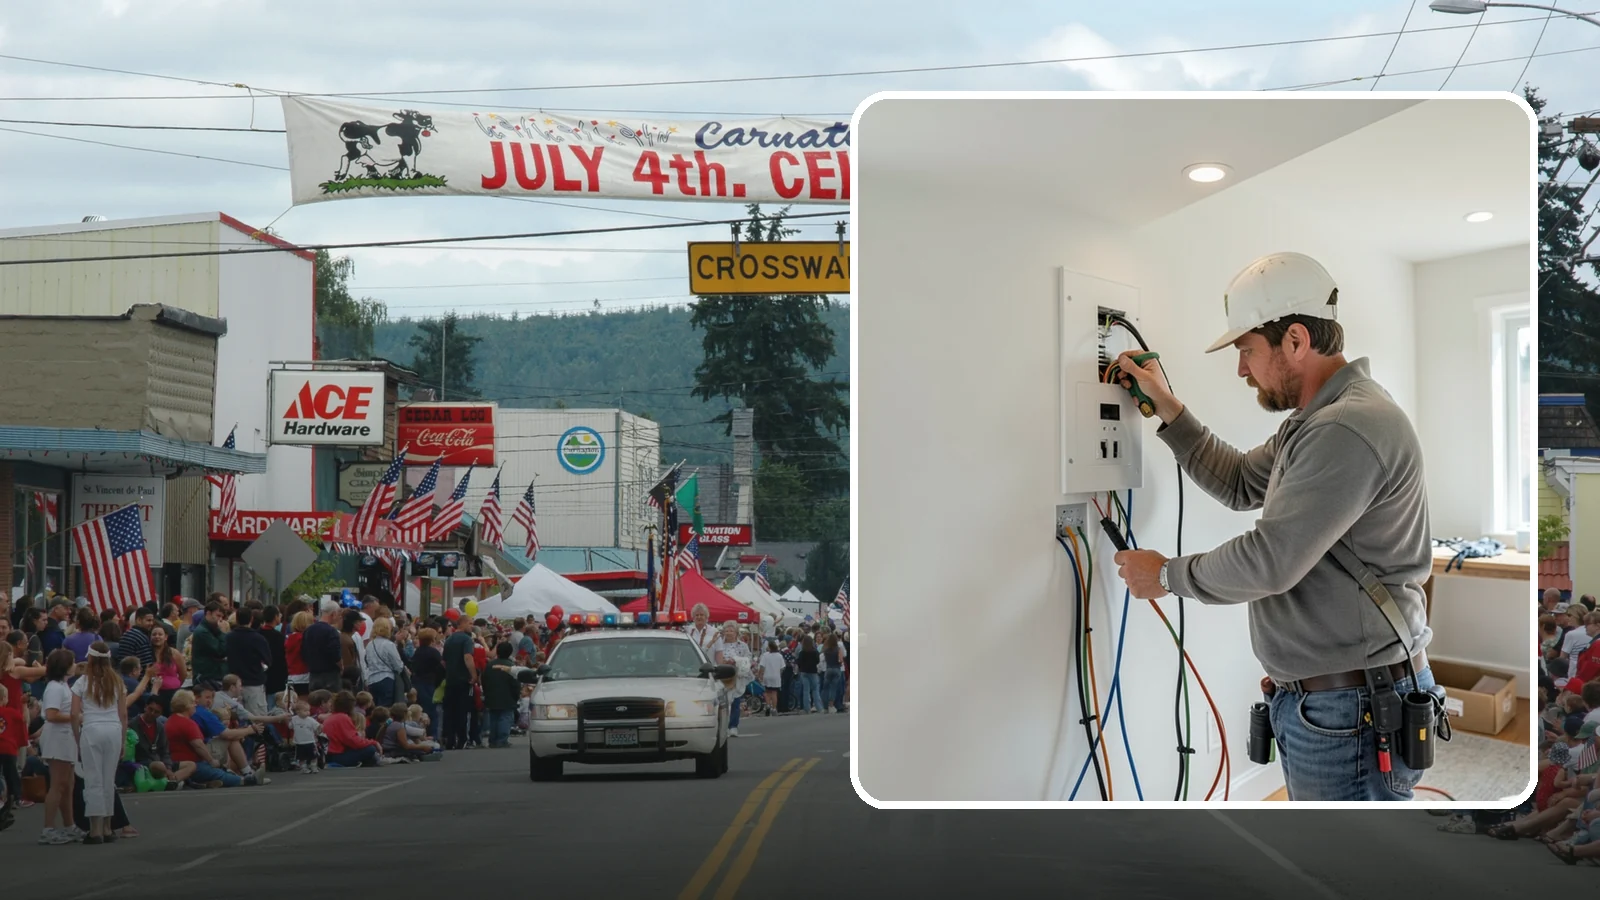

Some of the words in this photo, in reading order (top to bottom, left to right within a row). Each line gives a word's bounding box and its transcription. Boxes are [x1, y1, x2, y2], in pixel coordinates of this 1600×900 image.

[695, 121, 850, 149] Carnat
[481, 141, 605, 192] JULY
[632, 150, 746, 197] 4th.
[696, 254, 850, 280] CROSSWA
[283, 380, 373, 420] ACE
[405, 409, 453, 422] CEDAR
[283, 421, 371, 436] Hardware
[353, 467, 385, 480] Simpl
[95, 485, 124, 495] Vincent
[126, 486, 136, 495] de
[137, 486, 155, 495] Paul
[81, 503, 154, 522] THT
[688, 526, 742, 535] CRNATION
[699, 535, 731, 543] GLASS
